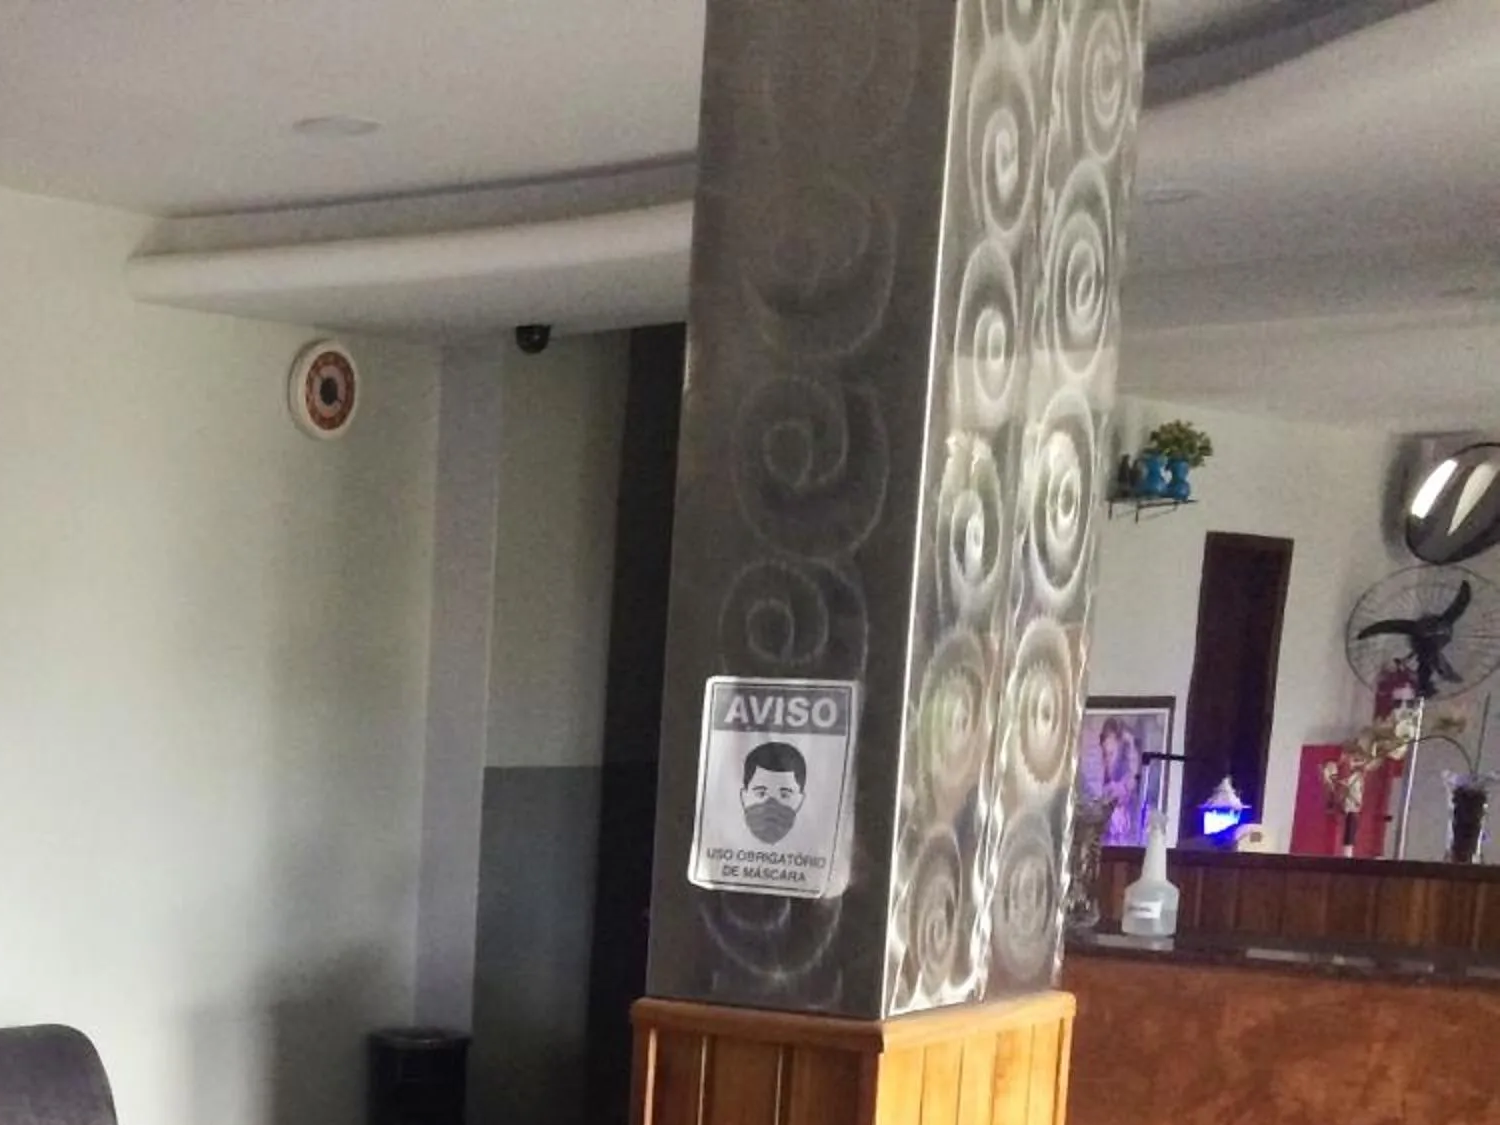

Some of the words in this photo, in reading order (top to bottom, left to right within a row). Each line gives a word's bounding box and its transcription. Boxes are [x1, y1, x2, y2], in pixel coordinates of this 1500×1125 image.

[724, 695, 838, 728] AVISO
[706, 848, 733, 861] USO
[736, 849, 827, 869] OBRIGATÓRIO
[722, 864, 740, 877] DE
[743, 865, 807, 881] MÁSCARA
